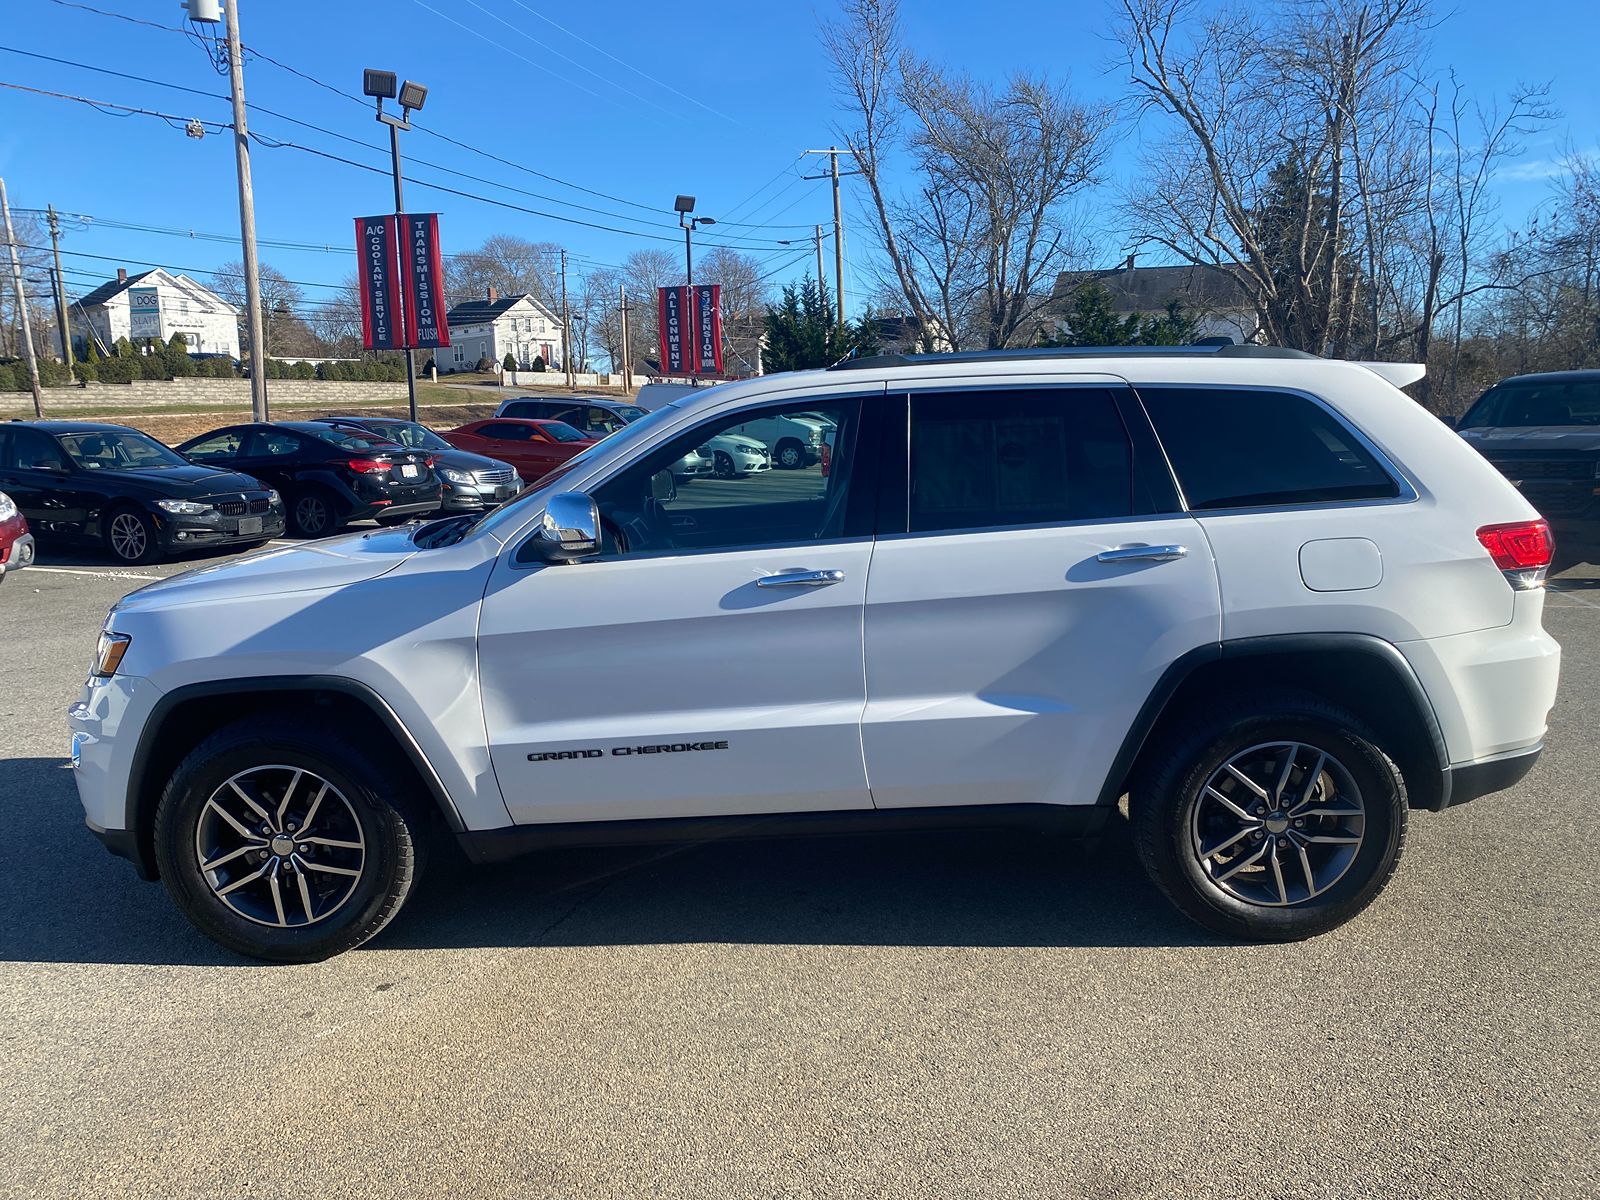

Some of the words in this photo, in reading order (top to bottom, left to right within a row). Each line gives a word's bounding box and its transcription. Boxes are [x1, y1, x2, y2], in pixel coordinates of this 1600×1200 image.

[366, 225, 384, 235] A/C
[371, 237, 383, 288] COOLANT
[415, 221, 432, 325] TRANSMISSION
[136, 296, 157, 304] DOG
[374, 290, 387, 341] SERVICE
[417, 328, 439, 340] FLUSH
[668, 291, 680, 368] ALIGNMENT
[527, 749, 604, 762] GRAND
[611, 740, 729, 756] CHEROKEE
